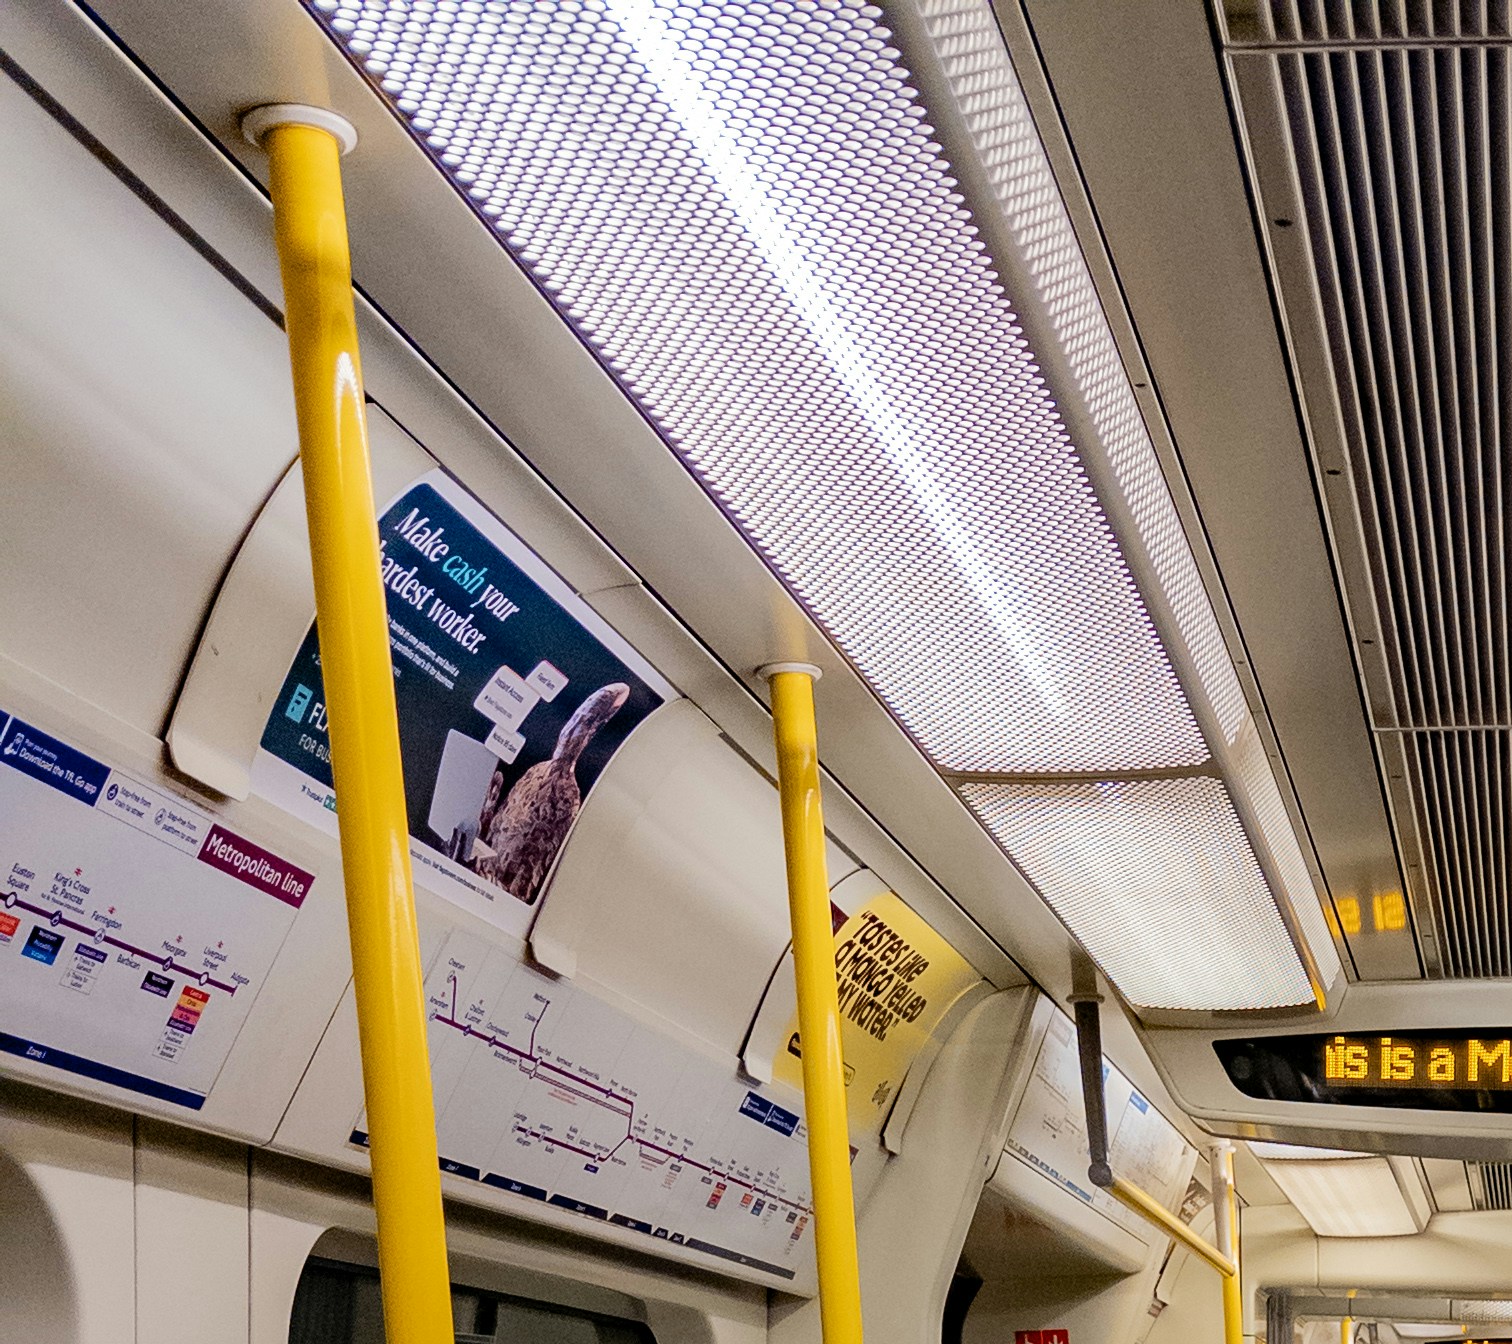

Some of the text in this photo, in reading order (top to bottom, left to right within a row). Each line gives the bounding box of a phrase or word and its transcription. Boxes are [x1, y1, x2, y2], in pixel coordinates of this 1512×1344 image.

[394, 507, 520, 622] Make cash your
[427, 598, 486, 655] worker.
[299, 733, 316, 754] FOR
[19, 747, 54, 772] Download
[52, 764, 65, 778] the
[75, 776, 85, 788] Go
[12, 863, 36, 879] Euston
[206, 833, 304, 898] Metropolitan line
[6, 875, 30, 891] Square
[73, 881, 91, 895] Cross
[60, 888, 84, 905] Pancras
[91, 911, 122, 930] Farringdon
[116, 954, 141, 970] Barbican
[1380, 1037, 1415, 1080] is
[1430, 1047, 1455, 1082] a
